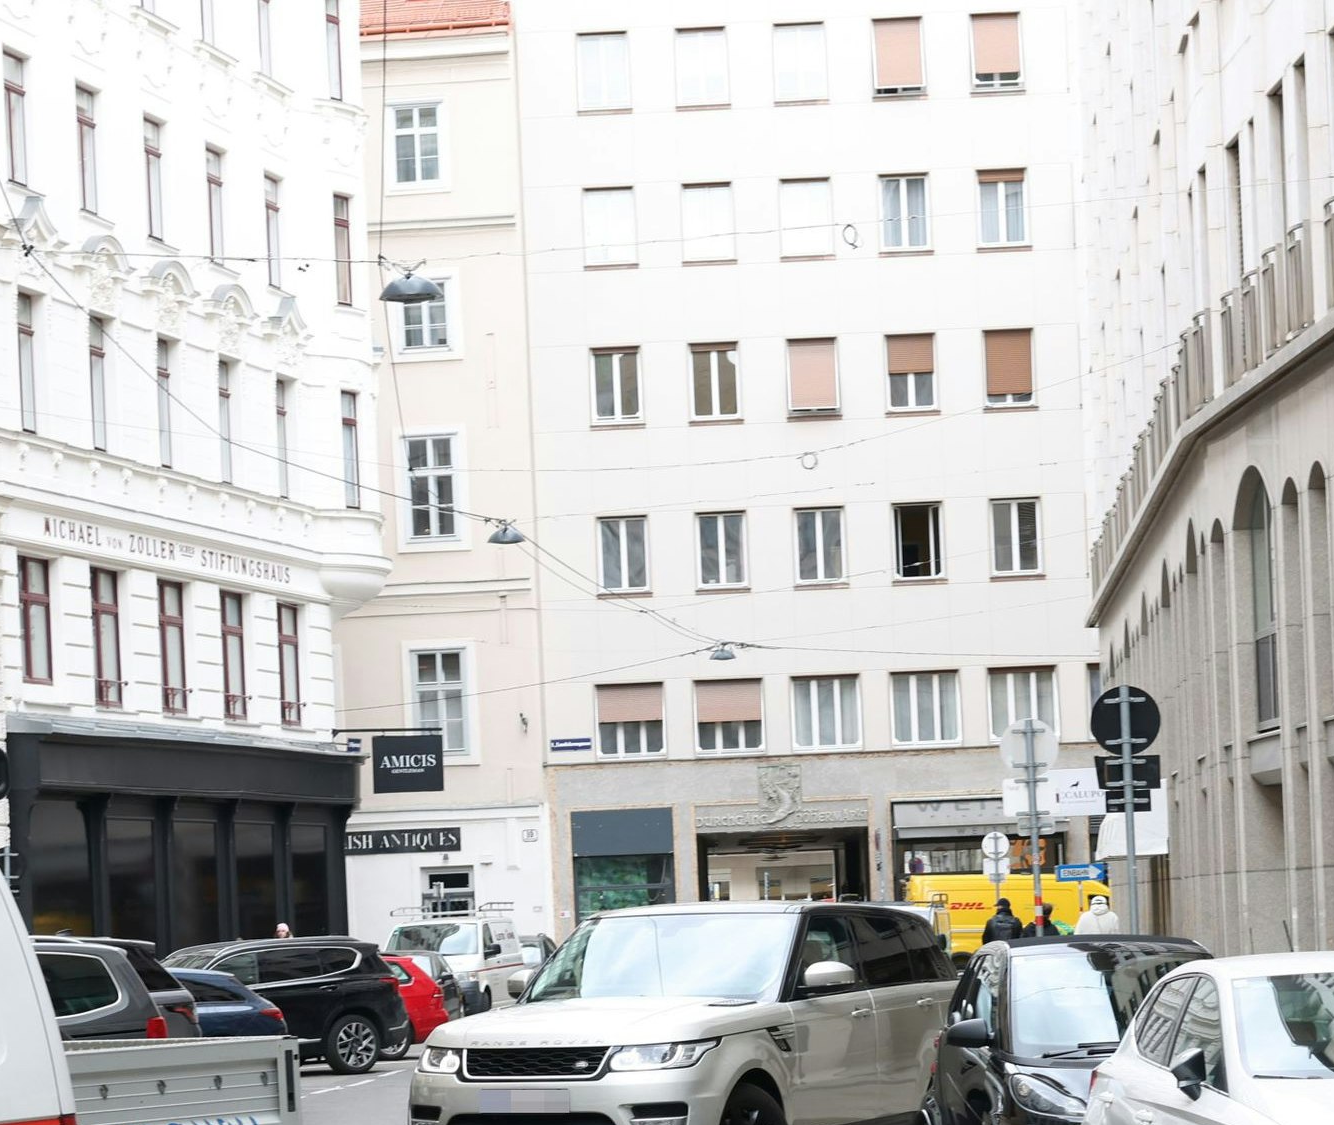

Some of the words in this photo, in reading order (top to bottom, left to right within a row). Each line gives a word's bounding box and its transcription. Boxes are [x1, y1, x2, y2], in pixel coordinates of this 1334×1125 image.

[129, 534, 177, 561] ZOLLER
[201, 550, 291, 584] STIFTUNGSHAUS
[379, 754, 437, 769] AMICIS
[345, 834, 373, 850] ISH
[379, 831, 458, 850] ANTIQUES
[950, 902, 985, 910] DHL
